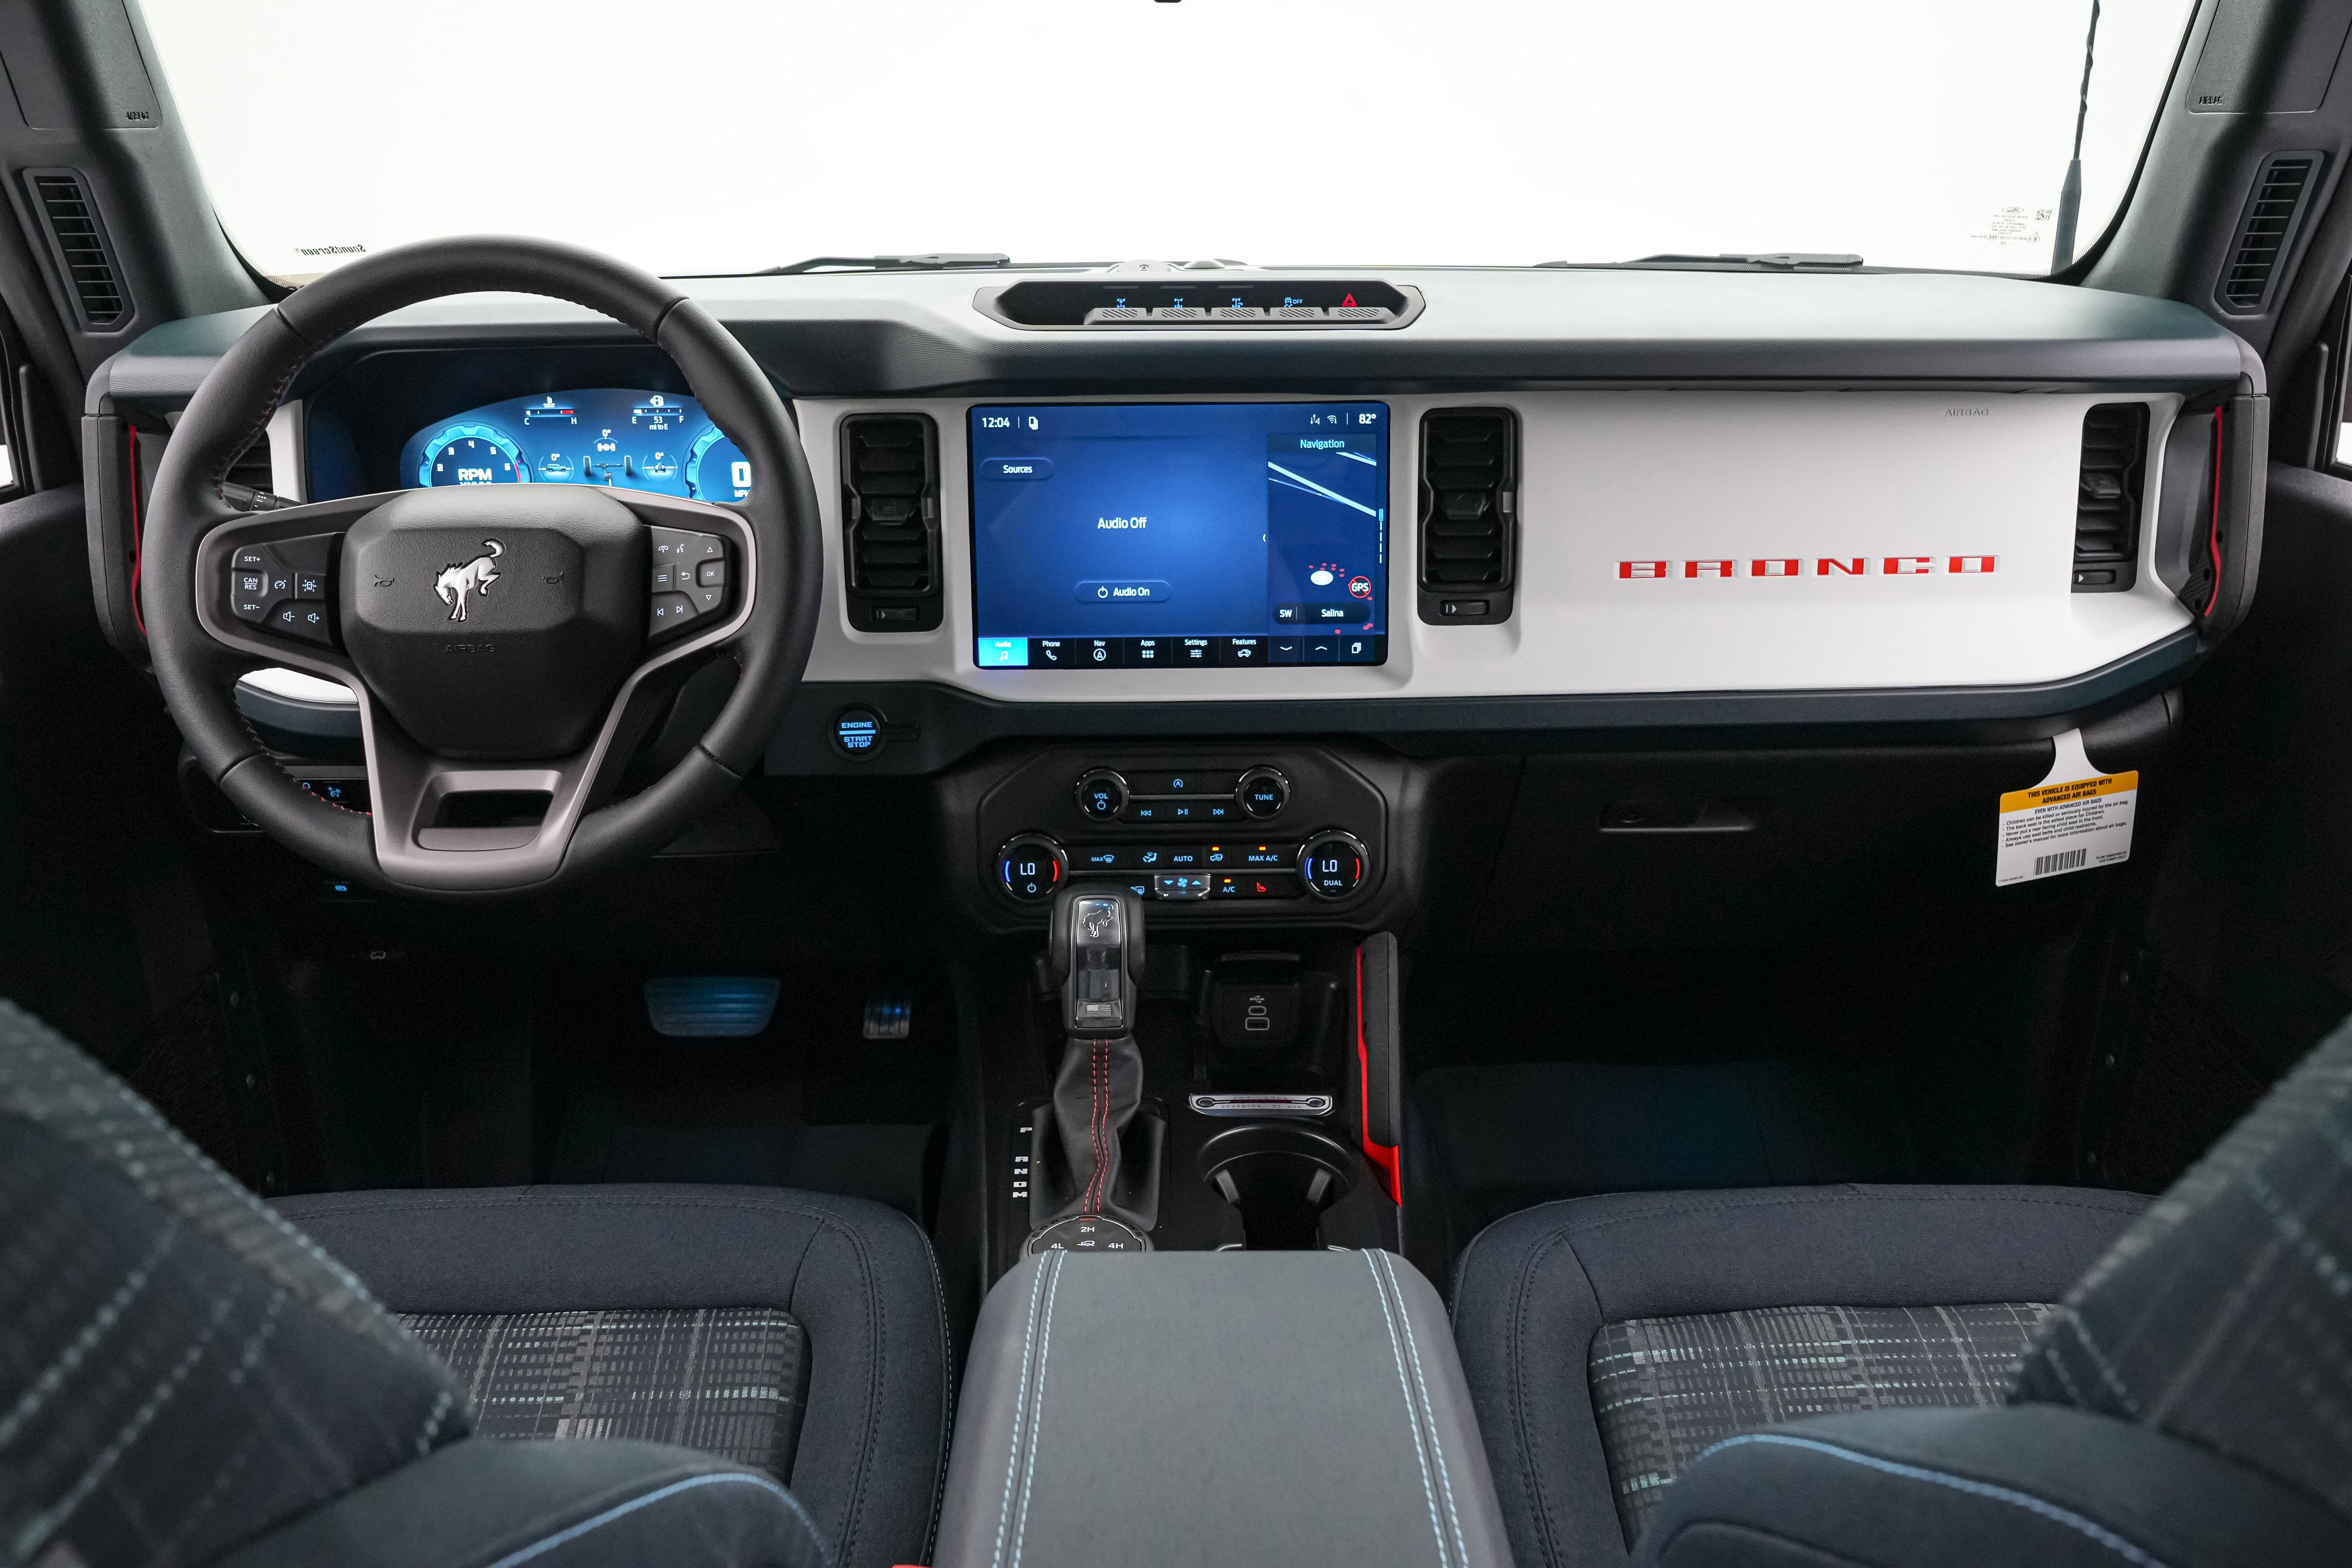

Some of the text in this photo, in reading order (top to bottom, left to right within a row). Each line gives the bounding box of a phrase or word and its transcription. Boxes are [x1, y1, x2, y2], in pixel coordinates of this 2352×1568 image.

[524, 417, 530, 425] C
[632, 416, 637, 424] E
[982, 417, 1010, 428] 12:04
[1359, 413, 1376, 424] 82°
[468, 440, 474, 448] 4
[1300, 439, 1345, 450] Navigation
[448, 447, 454, 455] 3
[490, 446, 497, 455] 5
[437, 463, 443, 472] 2
[504, 463, 510, 471] 6
[1003, 465, 1033, 474] Sources
[458, 468, 492, 481] RPM
[731, 461, 752, 488] 0
[1097, 517, 1147, 529] Audio Off
[1617, 556, 1998, 579] BRONCO
[1113, 587, 1150, 597] Audio On
[1351, 583, 1369, 592] GPS
[1279, 609, 1292, 617] SW
[1321, 608, 1344, 617] Salina
[2042, 786, 2063, 796] VEHICLE
[2071, 781, 2097, 791] EQUIPPED
[2098, 778, 2112, 786] WITH
[2042, 794, 2071, 804] ADVANCED
[2059, 802, 2081, 810] ADVANCED
[1020, 862, 1036, 875] LO
[1322, 859, 1338, 873] LO
